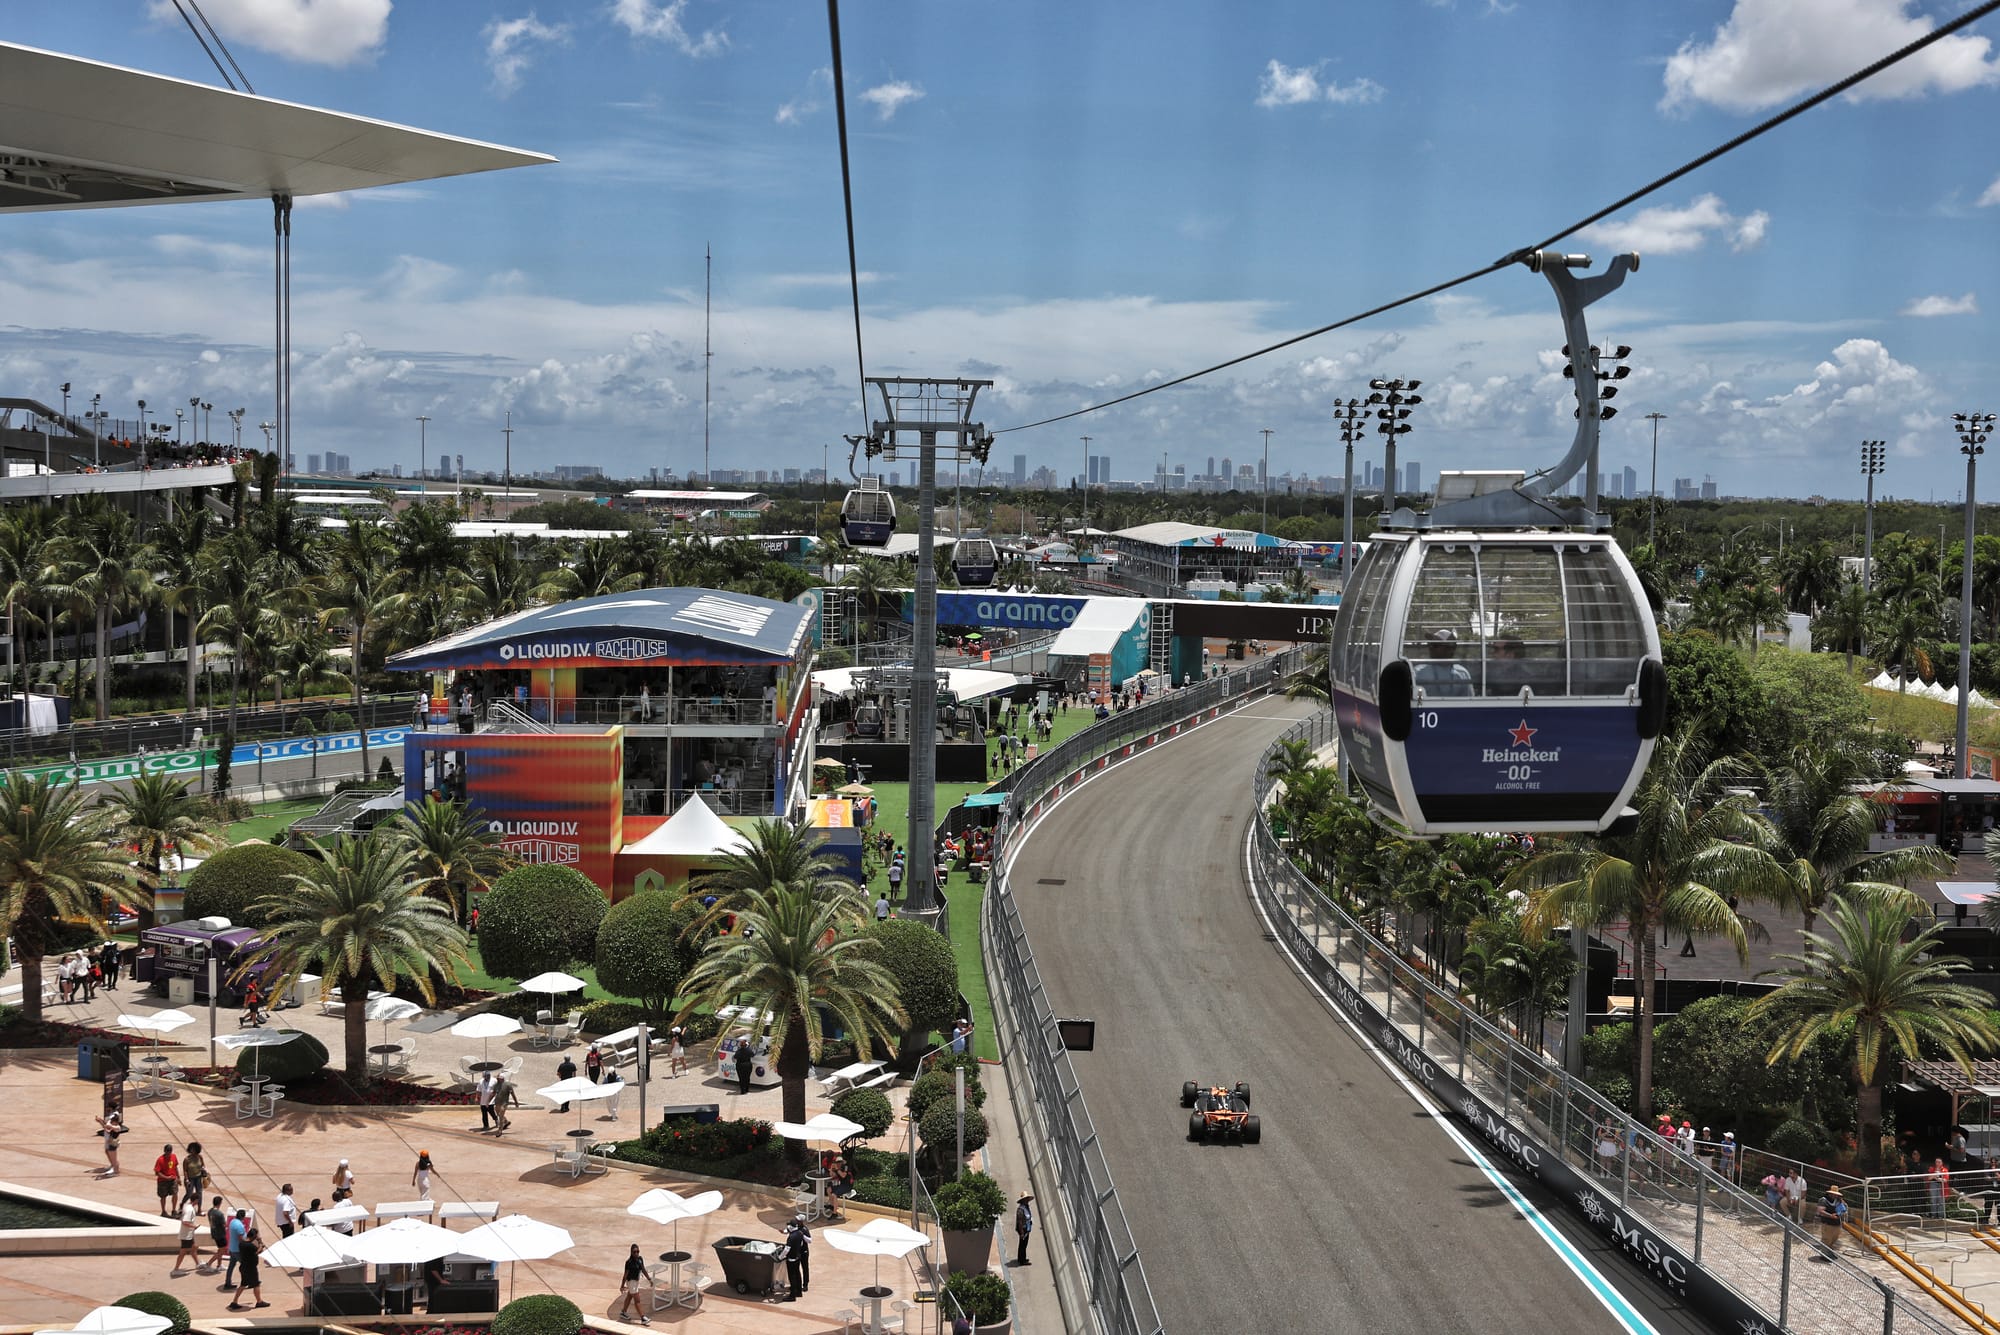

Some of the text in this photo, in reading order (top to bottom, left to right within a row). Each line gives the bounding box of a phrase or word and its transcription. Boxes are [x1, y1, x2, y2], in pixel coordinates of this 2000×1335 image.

[977, 601, 1078, 623] aramco
[1140, 607, 1150, 640] 9
[518, 643, 591, 659] LIQUID I.V.
[598, 640, 665, 659] RACEHOUSE
[1419, 712, 1438, 728] 10
[253, 730, 404, 757] aramco
[1482, 748, 1560, 762] Heineken
[1496, 782, 1523, 790] ALCOHOL
[507, 821, 578, 835] LIQUID I.V.
[1337, 980, 1364, 1015] MSC
[1398, 1039, 1434, 1081] MSC
[1486, 1113, 1540, 1168] MSC
[1612, 1212, 1687, 1284] MSC
[1611, 1233, 1686, 1297] CRUISES
